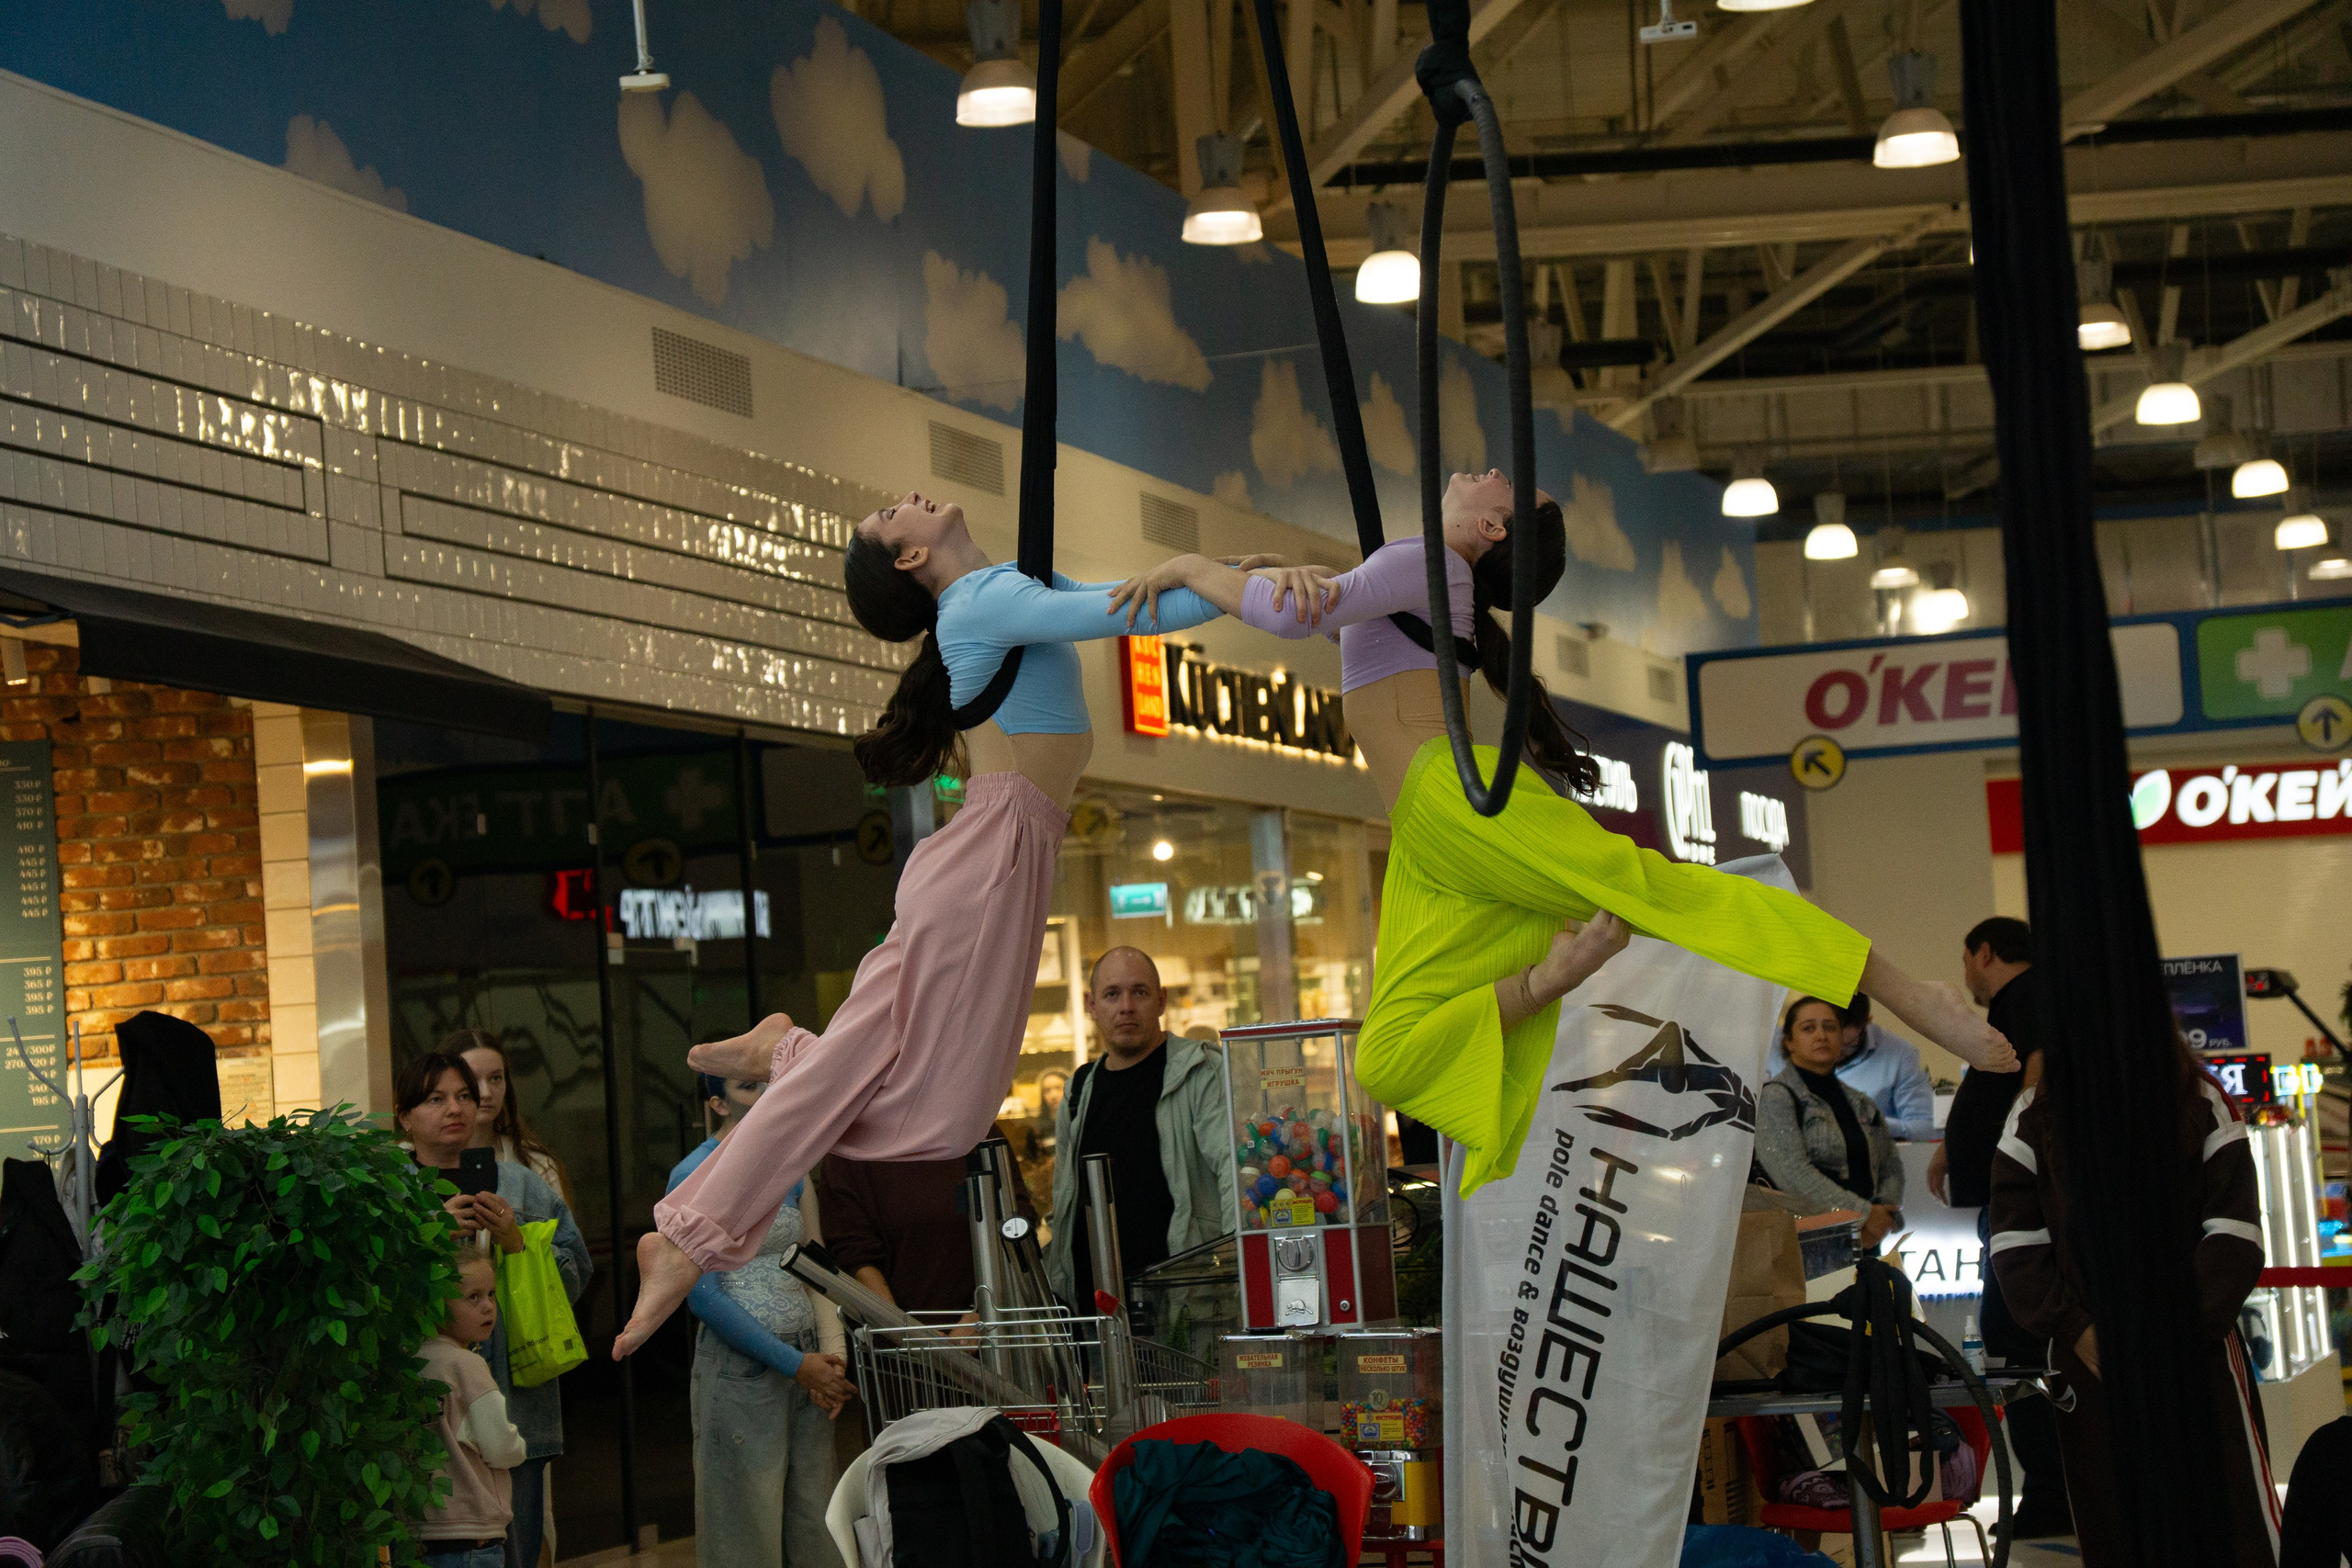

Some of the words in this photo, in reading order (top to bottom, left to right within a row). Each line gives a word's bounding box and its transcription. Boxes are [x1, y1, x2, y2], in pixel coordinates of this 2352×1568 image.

[1805, 652, 2018, 730] О'КЕ
[2160, 959, 2222, 976] ПЛЁНКА
[1267, 1078, 1300, 1088] ИГРУШКА
[1276, 1067, 1303, 1076] ПРЫГУН
[1545, 1127, 1576, 1190] pole
[1523, 1194, 1560, 1276] dance
[1517, 1280, 1540, 1301] &
[1514, 1146, 1638, 1568] НАШЕСТВ
